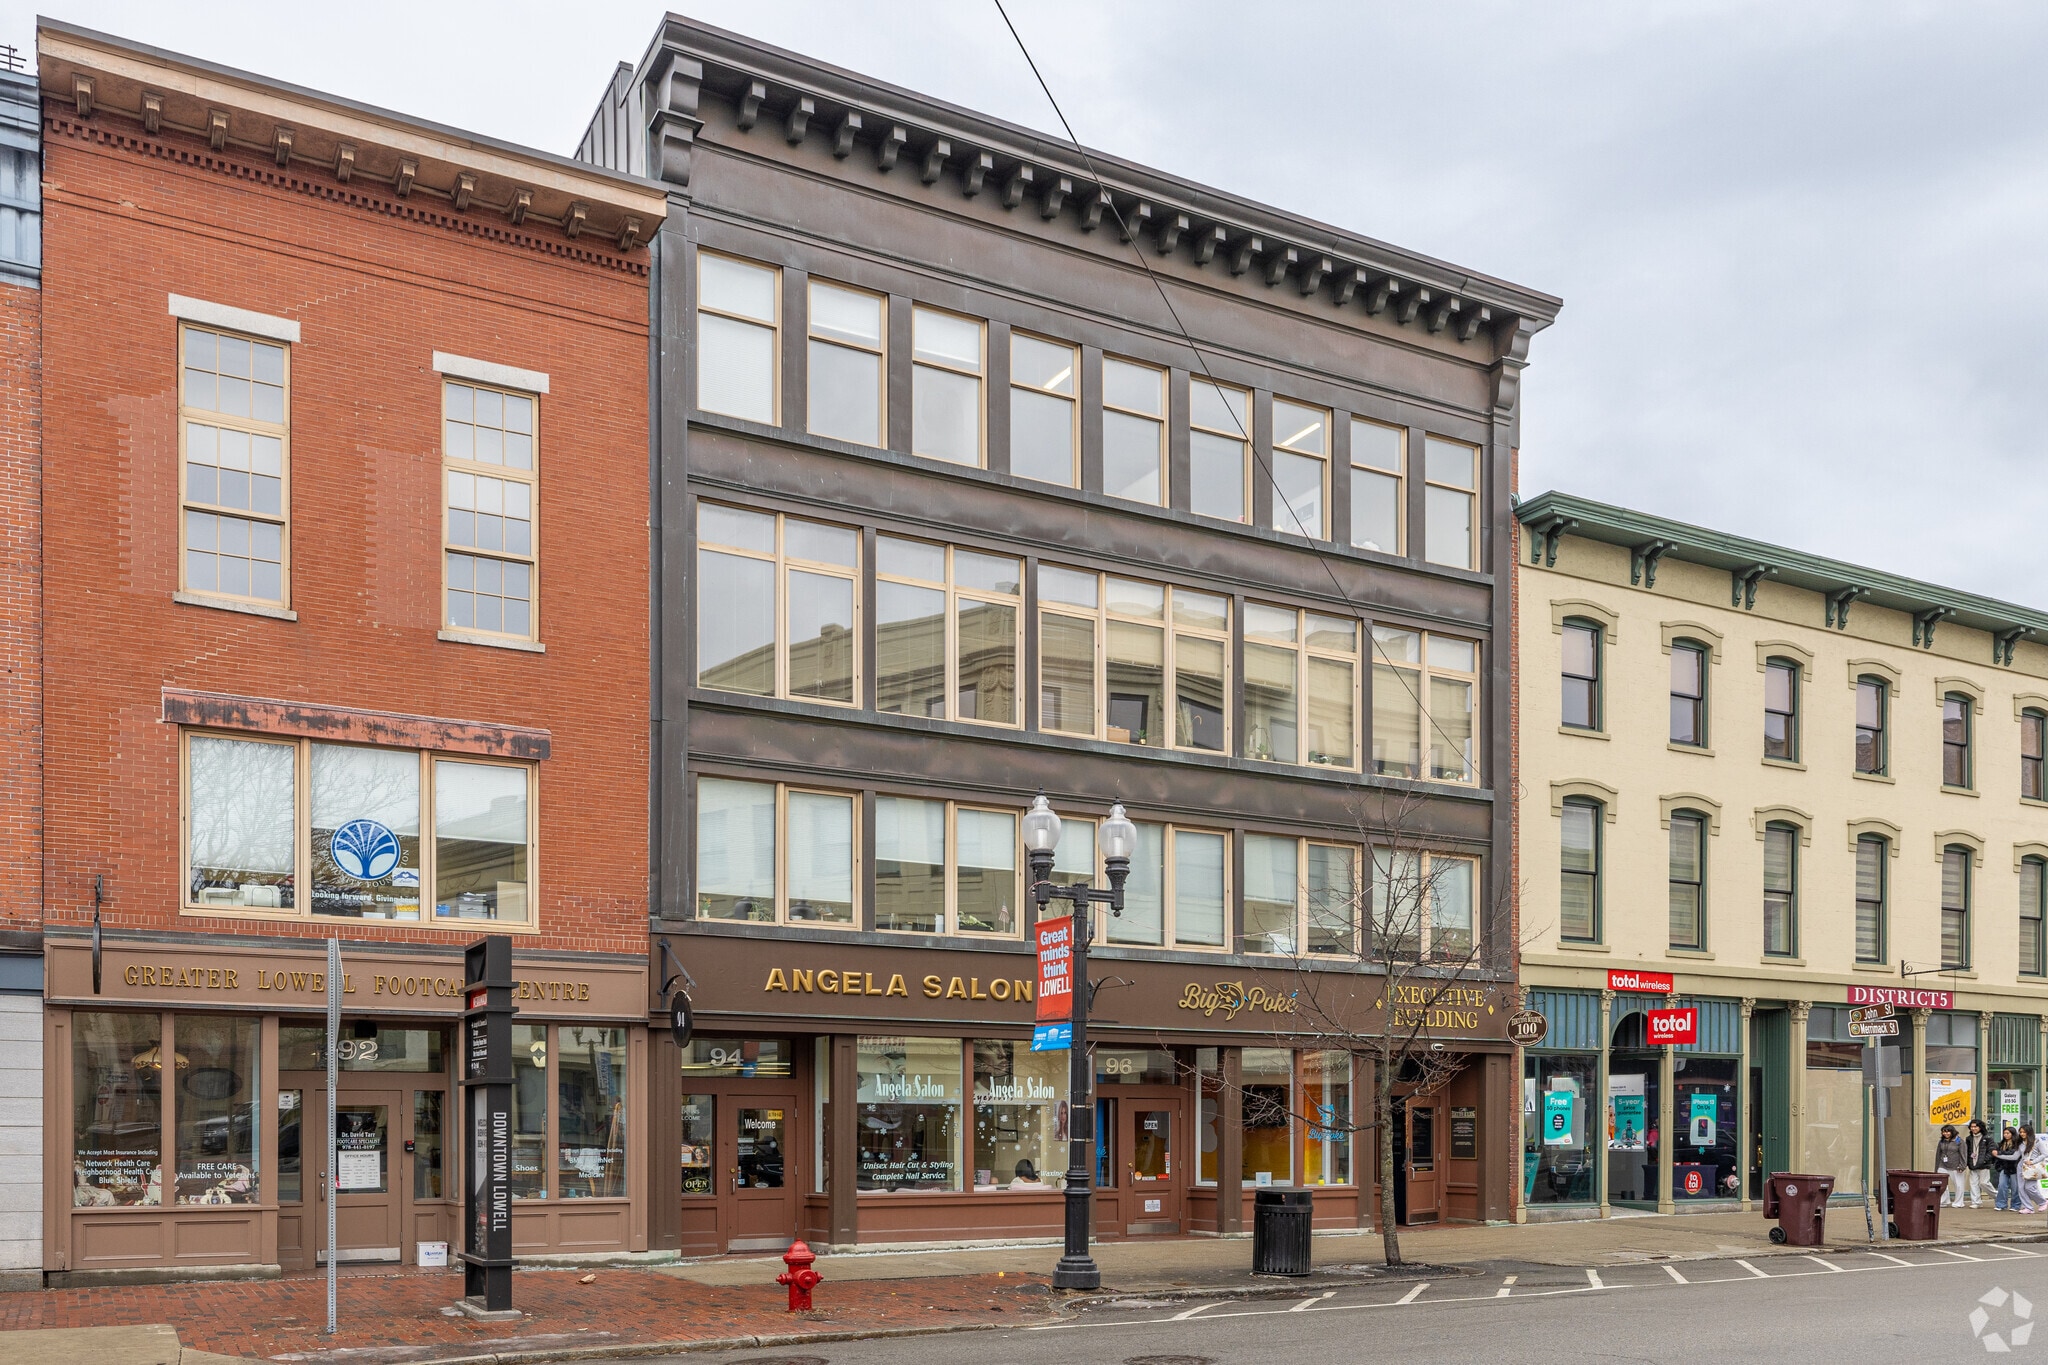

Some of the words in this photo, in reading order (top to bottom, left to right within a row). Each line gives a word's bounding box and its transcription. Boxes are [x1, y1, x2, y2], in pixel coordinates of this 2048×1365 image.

[311, 889, 339, 901] Looking
[341, 892, 374, 902] forward.
[1040, 926, 1068, 946] Great
[1040, 943, 1070, 962] minds
[1043, 960, 1068, 979] think
[124, 964, 239, 988] GREATER
[258, 969, 356, 993] LOWEL
[373, 975, 465, 998] FOOTCA
[764, 968, 908, 998] ANGELA
[923, 974, 1033, 1002] SALON
[1039, 976, 1072, 997] LOWELL
[1612, 974, 1640, 989] total
[1640, 980, 1671, 991] wireless
[1178, 982, 1222, 1017] Big
[1864, 1008, 1879, 1021] John
[1884, 1003, 1892, 1015] St
[1517, 1022, 1537, 1035] 100
[1652, 1012, 1692, 1032] total
[1860, 1023, 1888, 1035] Merrimack
[1889, 1022, 1896, 1034] St
[338, 1039, 379, 1061] 92
[710, 1048, 744, 1067] 94
[1105, 1057, 1132, 1074] 96
[875, 1074, 912, 1101] Angela
[914, 1074, 945, 1097] Salon
[989, 1076, 1023, 1101] Angela
[1027, 1076, 1055, 1099] Salon
[1932, 1100, 1960, 1115] COMING
[1943, 1106, 1967, 1122] SOON
[2002, 1104, 2019, 1113] FREE
[744, 1118, 777, 1129] Welcome
[493, 1111, 507, 1181] DOWNTOWN
[114, 1159, 135, 1167] Health
[515, 1164, 538, 1172] Shoes
[863, 1161, 887, 1169] Unisex
[889, 1161, 905, 1169] Hair
[907, 1161, 920, 1169] Cut
[930, 1161, 954, 1170] Styling
[76, 1168, 122, 1177] Neighborhood
[872, 1173, 904, 1181] Complete
[905, 1172, 920, 1180] Nail
[921, 1172, 946, 1180] Service
[685, 1179, 707, 1189] OPEN
[493, 1185, 507, 1232] LOWELL
